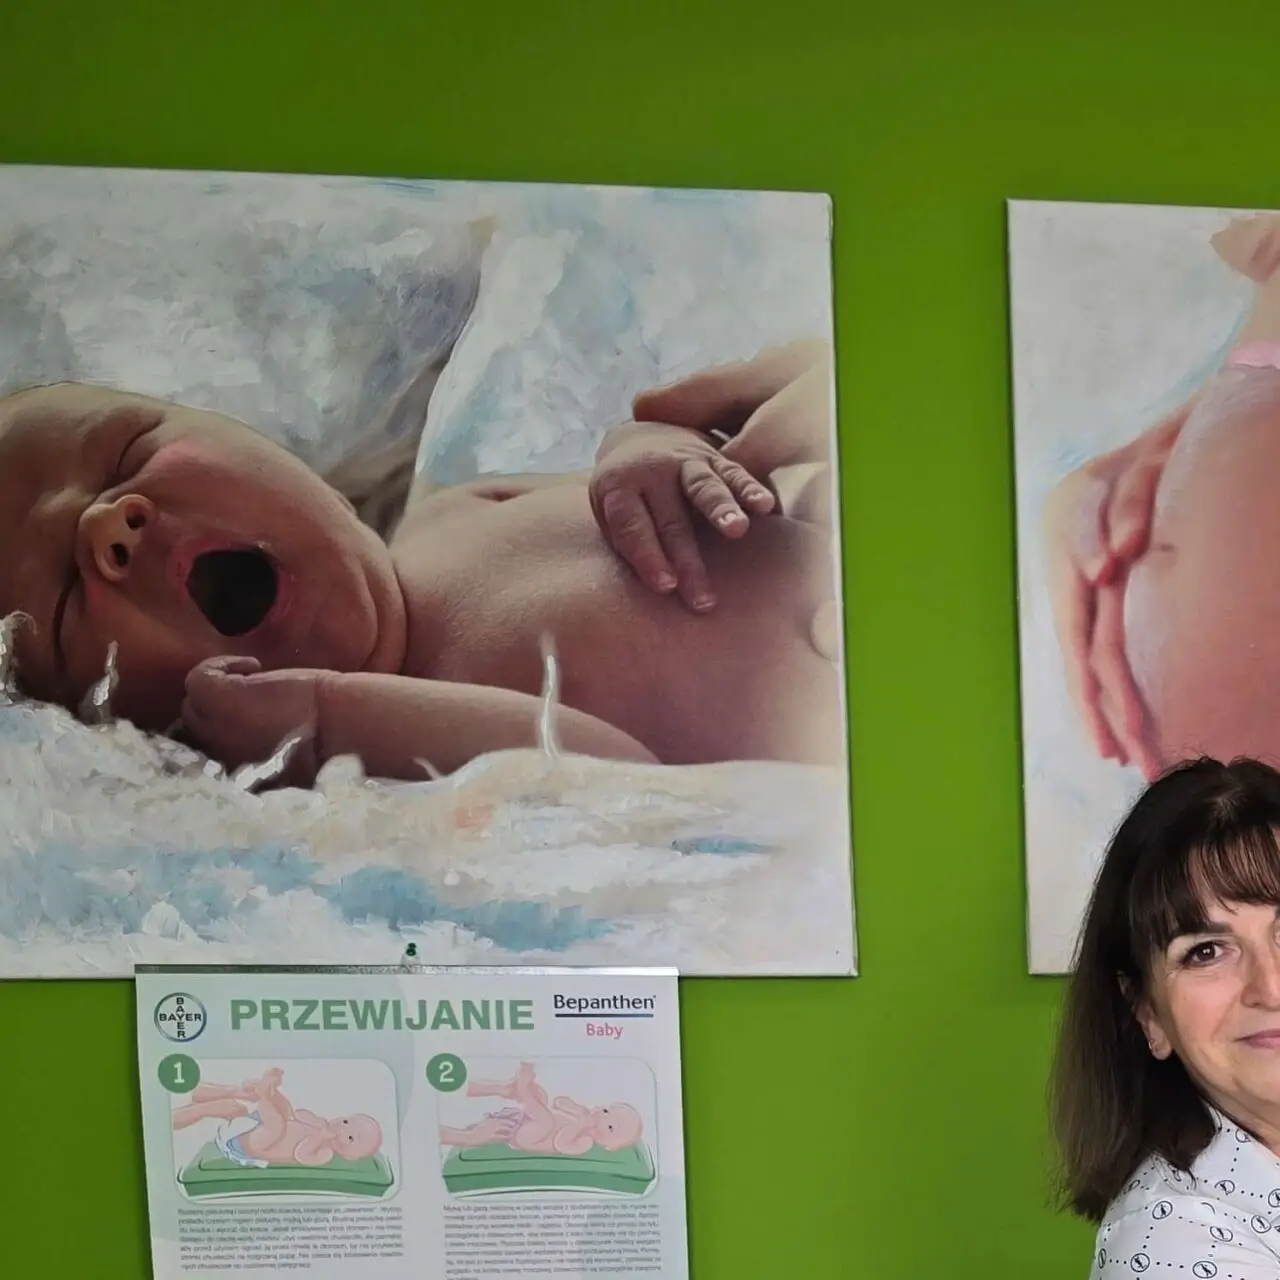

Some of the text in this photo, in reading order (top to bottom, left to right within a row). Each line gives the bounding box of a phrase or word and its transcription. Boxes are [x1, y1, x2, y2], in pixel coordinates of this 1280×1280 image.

[553, 994, 655, 1012] Bepanthen
[159, 1013, 202, 1022] BAYER
[230, 999, 535, 1031] PRZEWIJANIE
[586, 1023, 623, 1039] Baby
[173, 1063, 185, 1084] 1
[439, 1062, 455, 1083] 2
